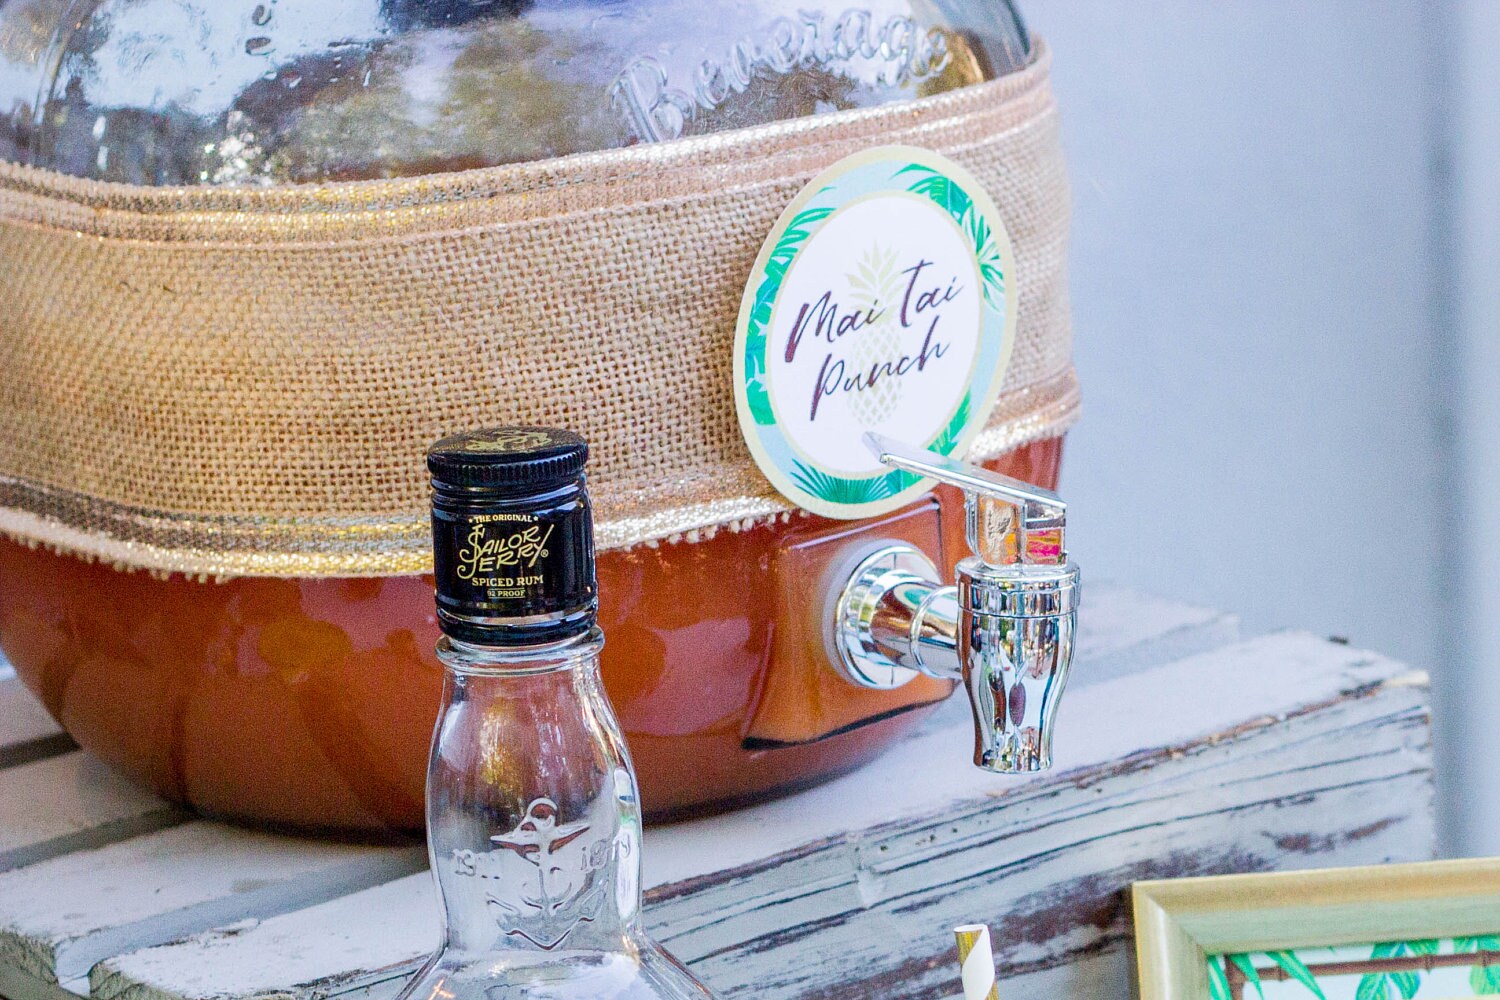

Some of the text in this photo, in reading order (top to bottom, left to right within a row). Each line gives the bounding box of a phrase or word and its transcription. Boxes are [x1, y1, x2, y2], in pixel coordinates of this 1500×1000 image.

[784, 259, 964, 363] Mai Tai
[810, 315, 950, 421] Punch
[474, 514, 533, 523] THE ORIGINAL
[460, 525, 541, 563] SAILOR
[472, 575, 544, 587] SPICED RUM
